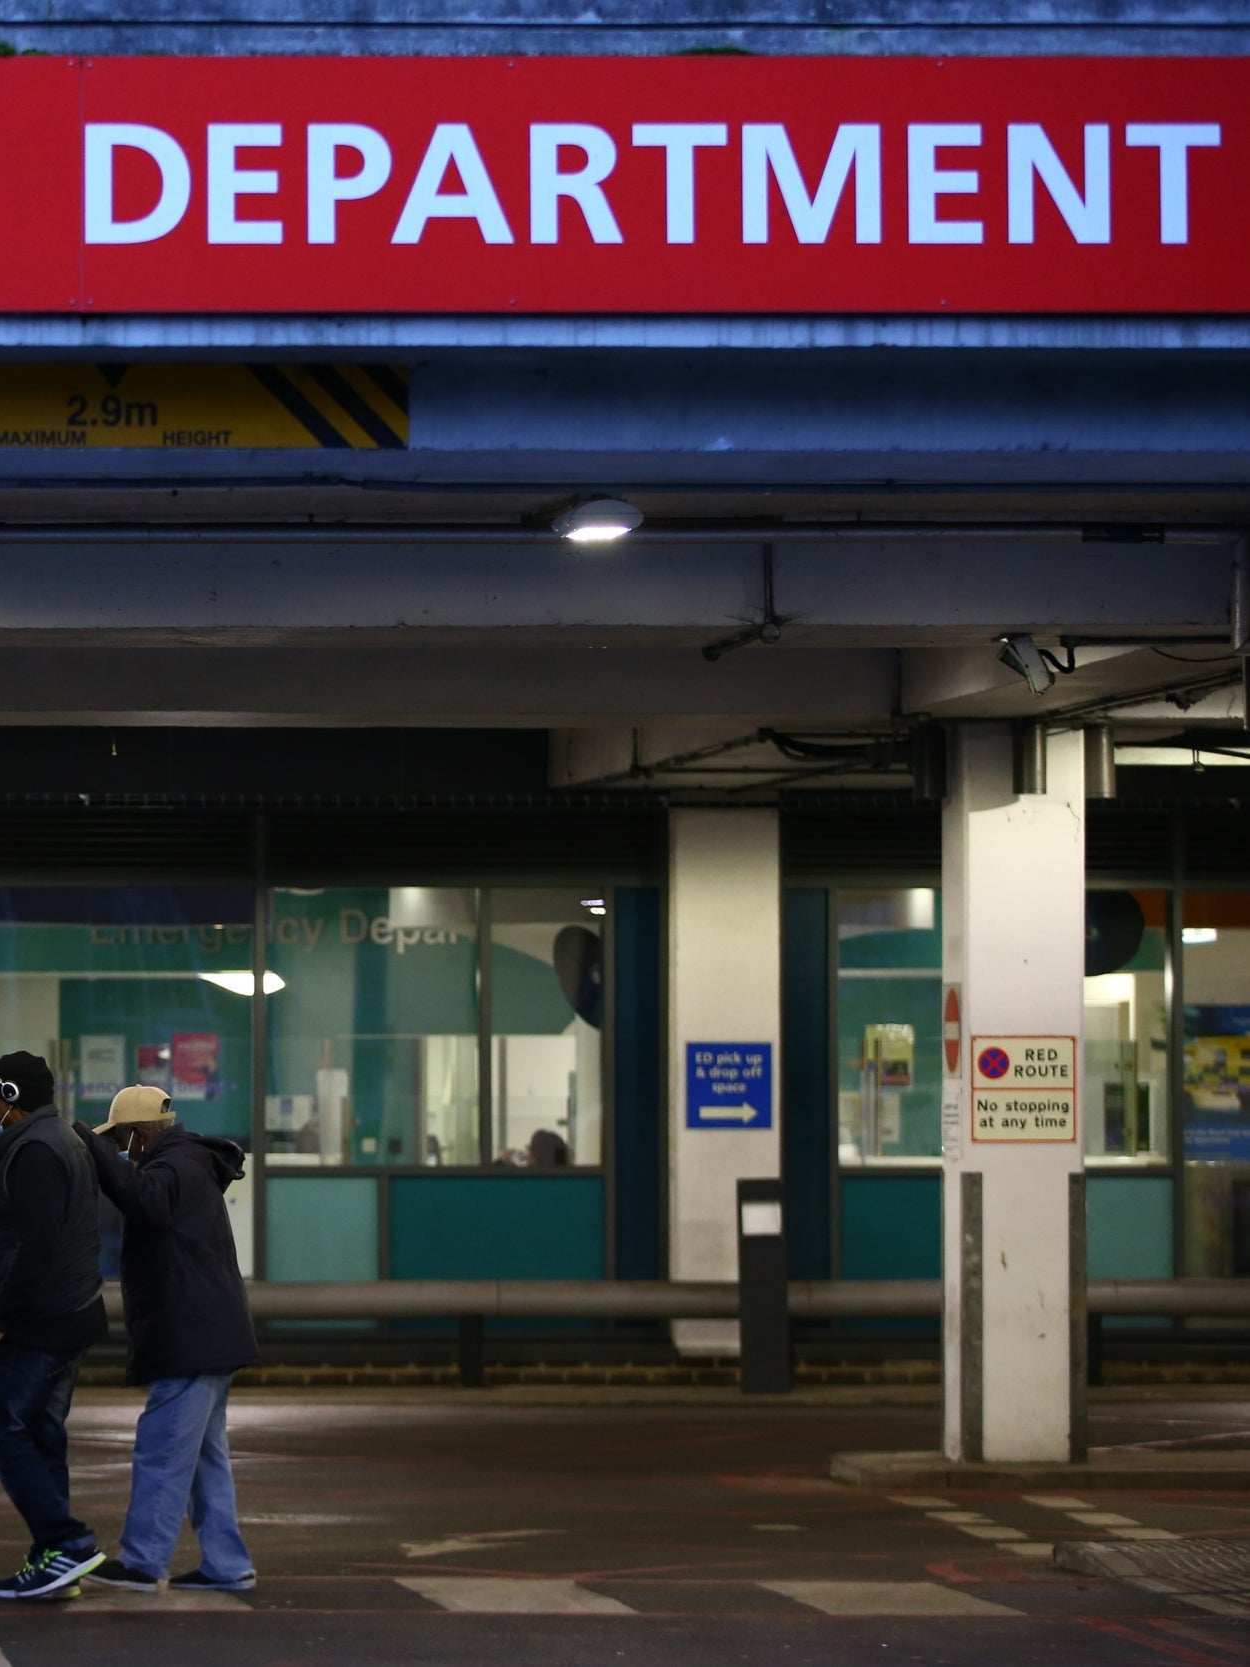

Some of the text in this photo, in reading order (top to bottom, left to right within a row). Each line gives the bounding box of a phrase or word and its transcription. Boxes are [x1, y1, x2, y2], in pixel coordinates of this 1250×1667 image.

[83, 121, 1221, 247] DEPARTMENT
[67, 395, 159, 427] 2.9m
[163, 430, 232, 446] HEIGHT
[695, 1051, 763, 1066] ED pick up
[1025, 1048, 1058, 1061] RED
[695, 1065, 762, 1080] & drop off
[1014, 1065, 1069, 1078] ROUTE
[711, 1082, 747, 1095] space
[977, 1099, 1070, 1113] No stopping
[979, 1115, 1067, 1129] at any time
